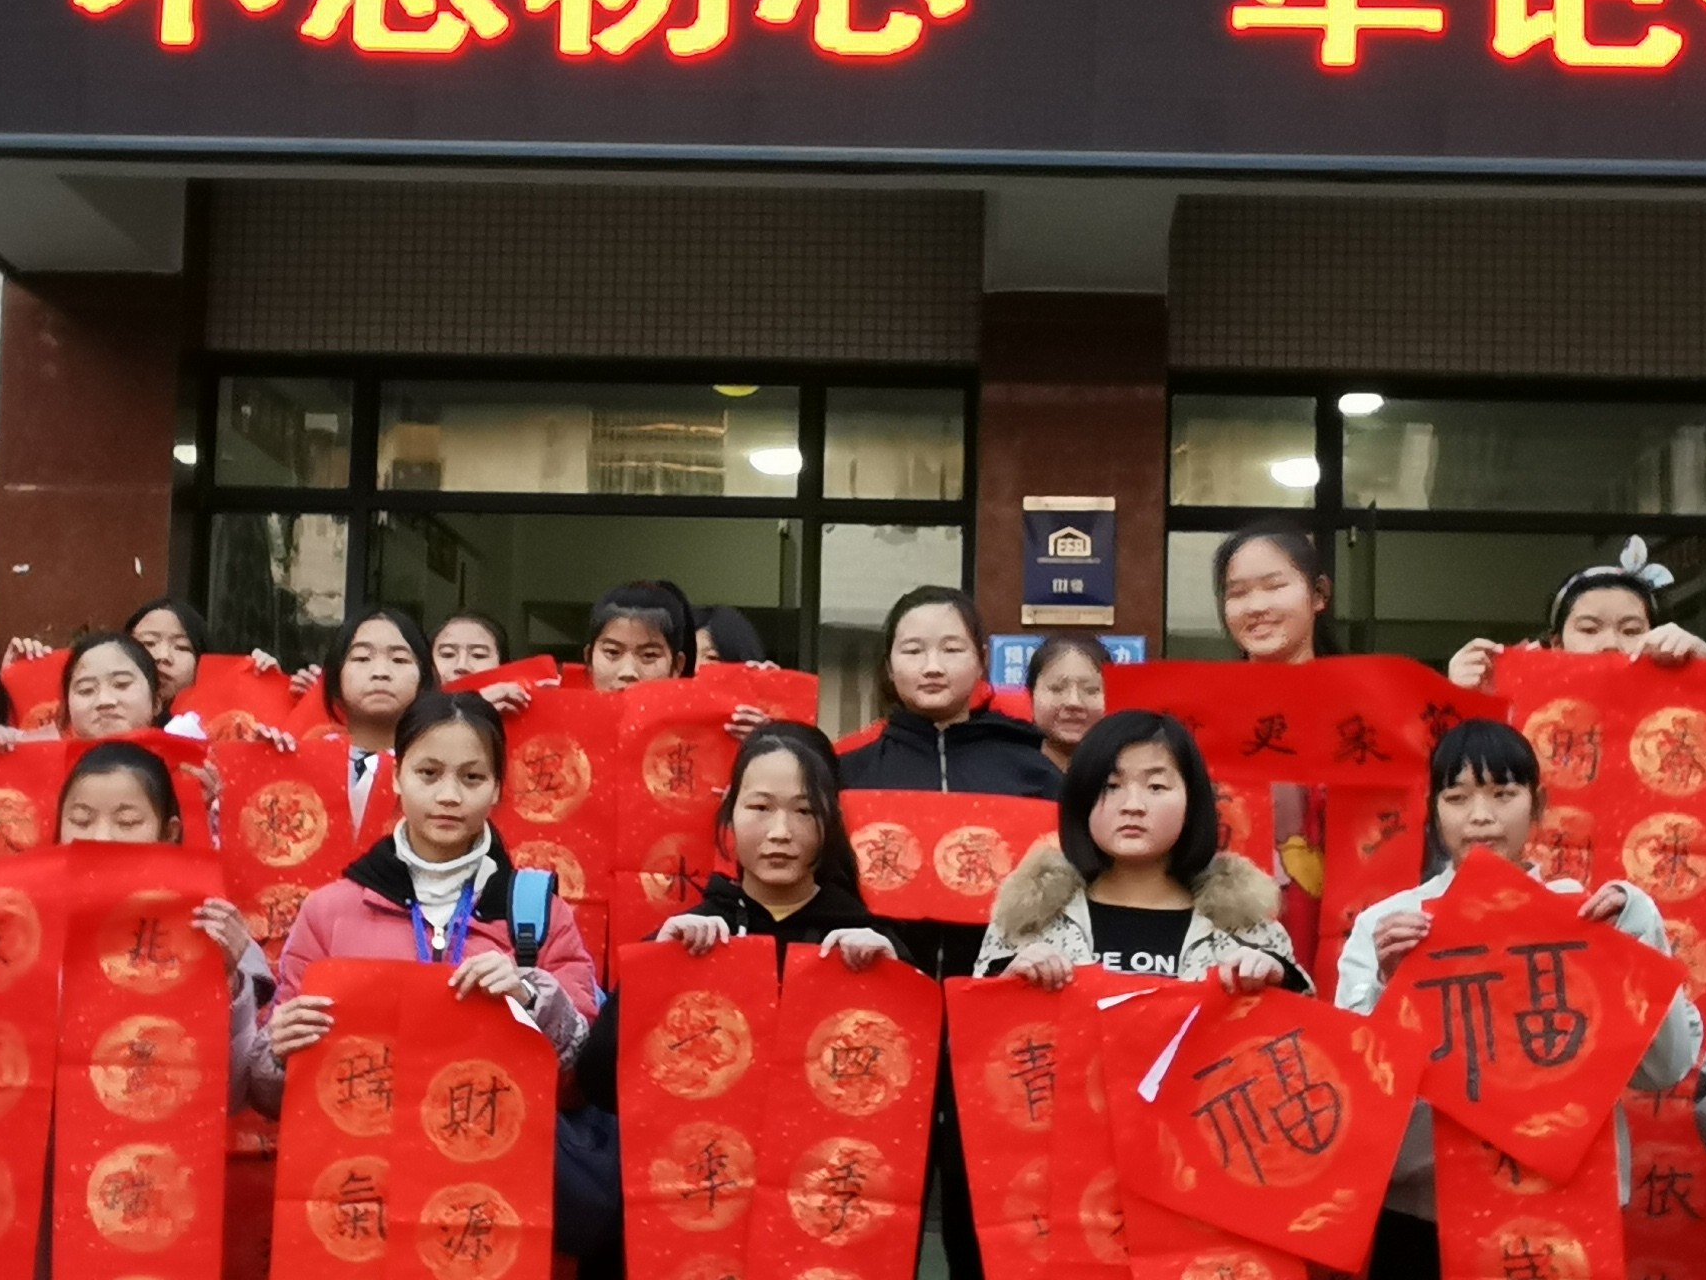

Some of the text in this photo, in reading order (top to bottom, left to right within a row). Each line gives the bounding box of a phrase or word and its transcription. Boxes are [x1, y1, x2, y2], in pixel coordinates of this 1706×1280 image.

[1130, 951, 1175, 974] ON
[1413, 940, 1591, 1104] 福
[1189, 1026, 1343, 1185] 福
